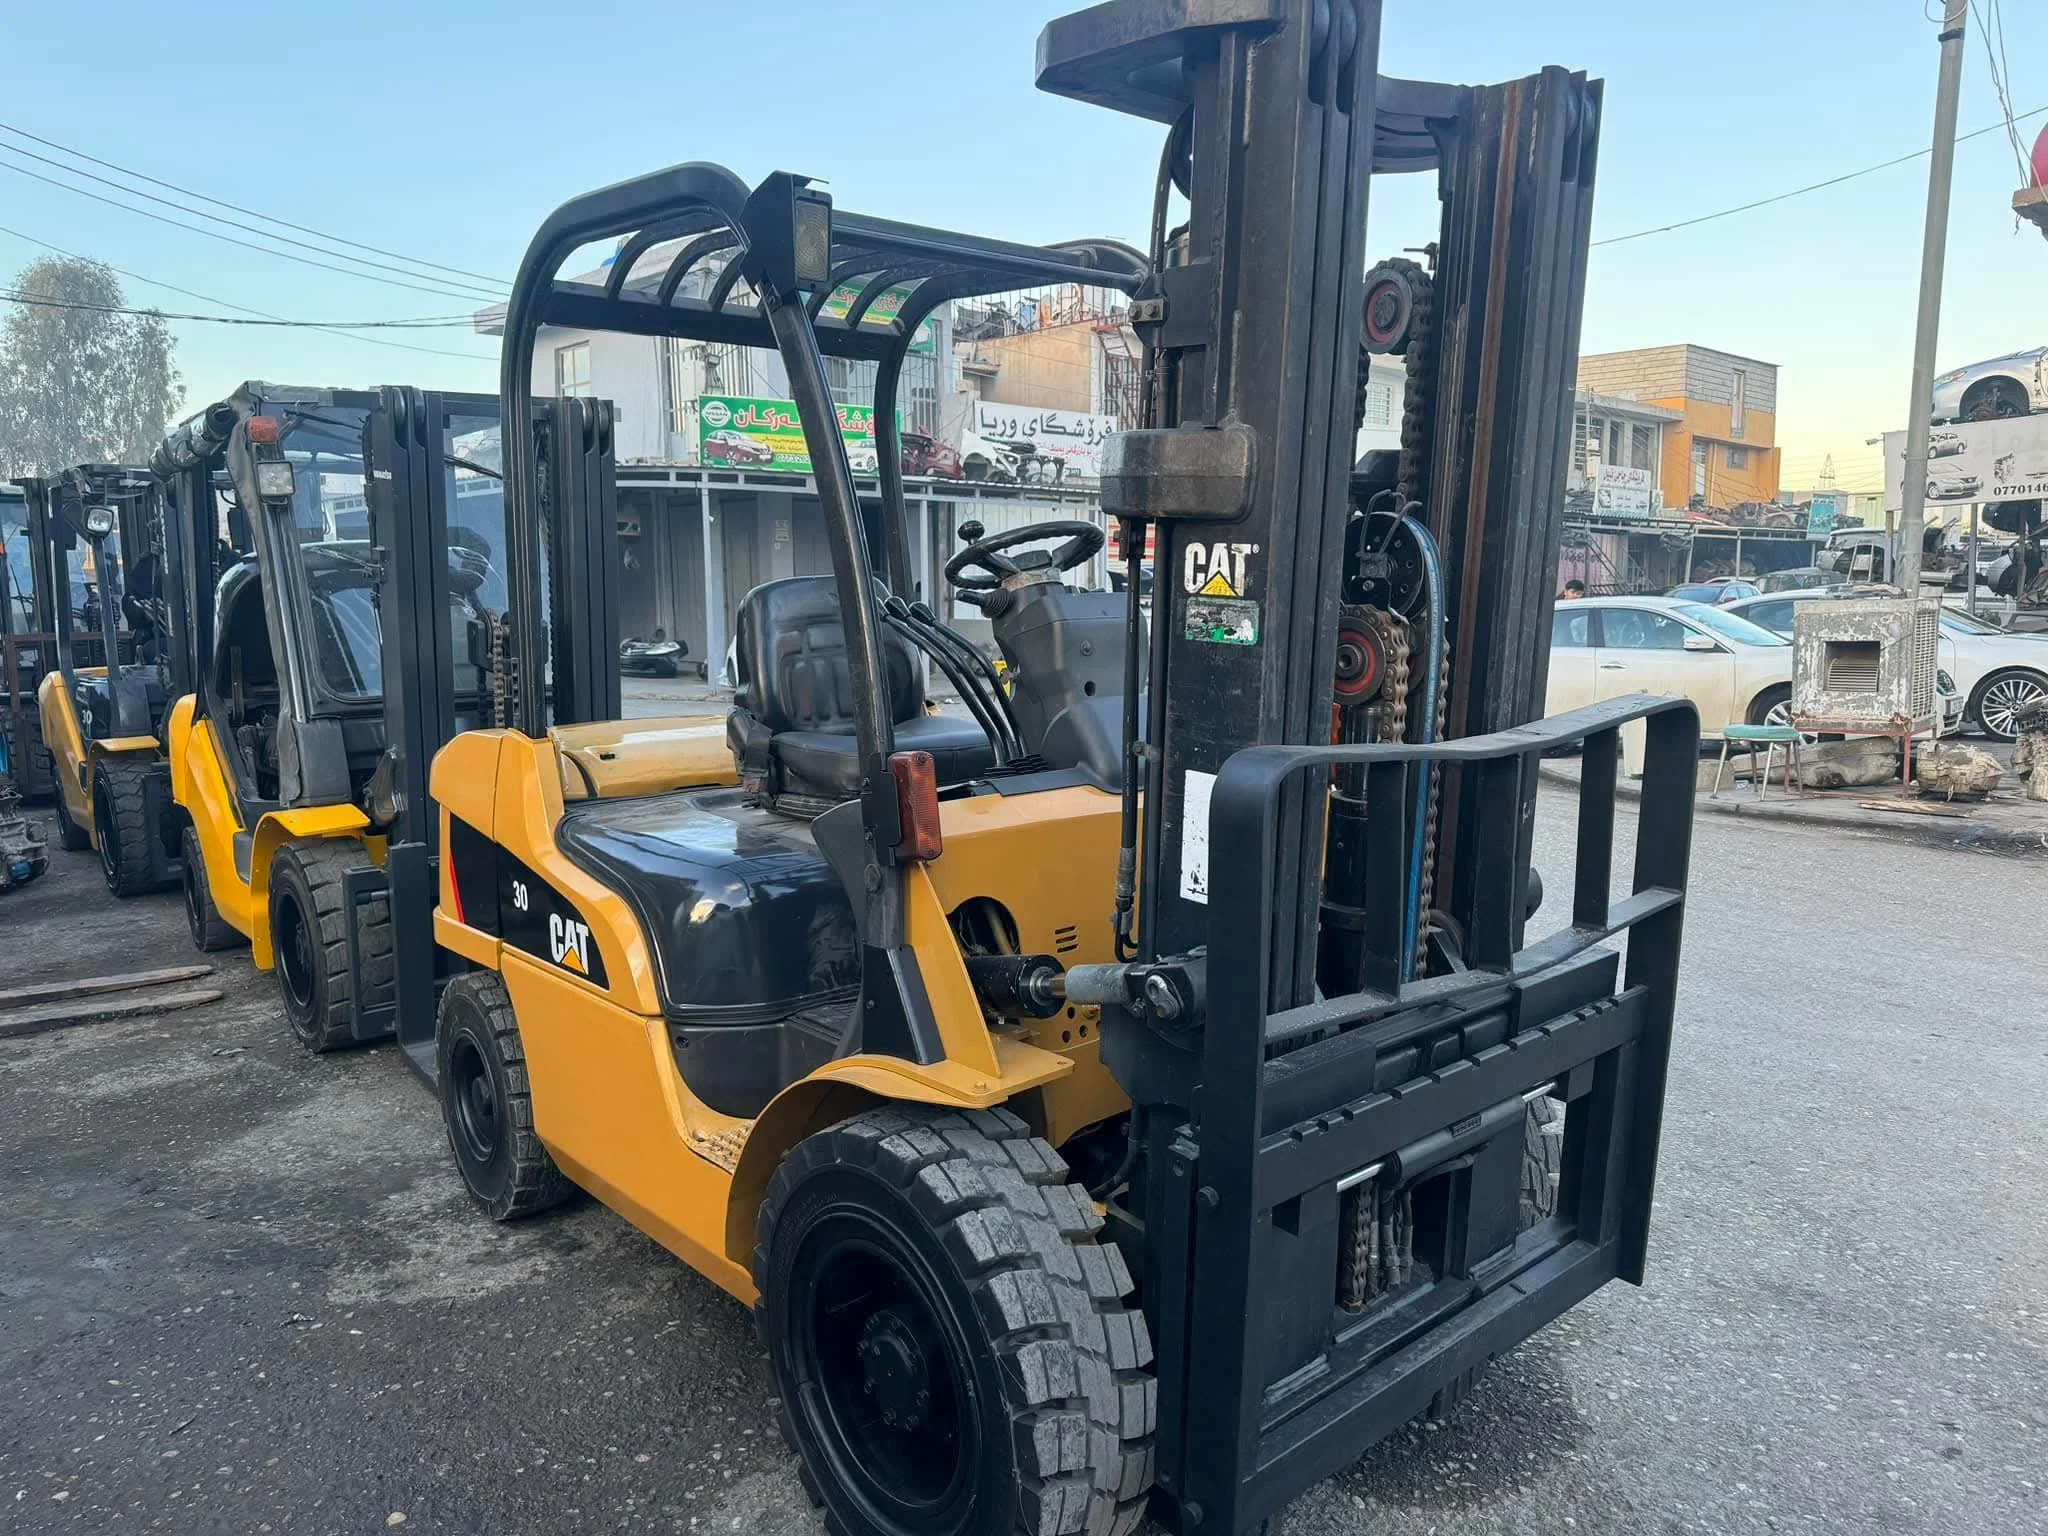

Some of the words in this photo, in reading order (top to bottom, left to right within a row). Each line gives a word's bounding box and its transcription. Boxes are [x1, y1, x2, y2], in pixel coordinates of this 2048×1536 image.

[734, 405, 802, 431] ەرکان
[980, 407, 1017, 438] وریا
[82, 709, 93, 724] 30
[512, 880, 529, 911] 30
[549, 912, 590, 976] CAT
